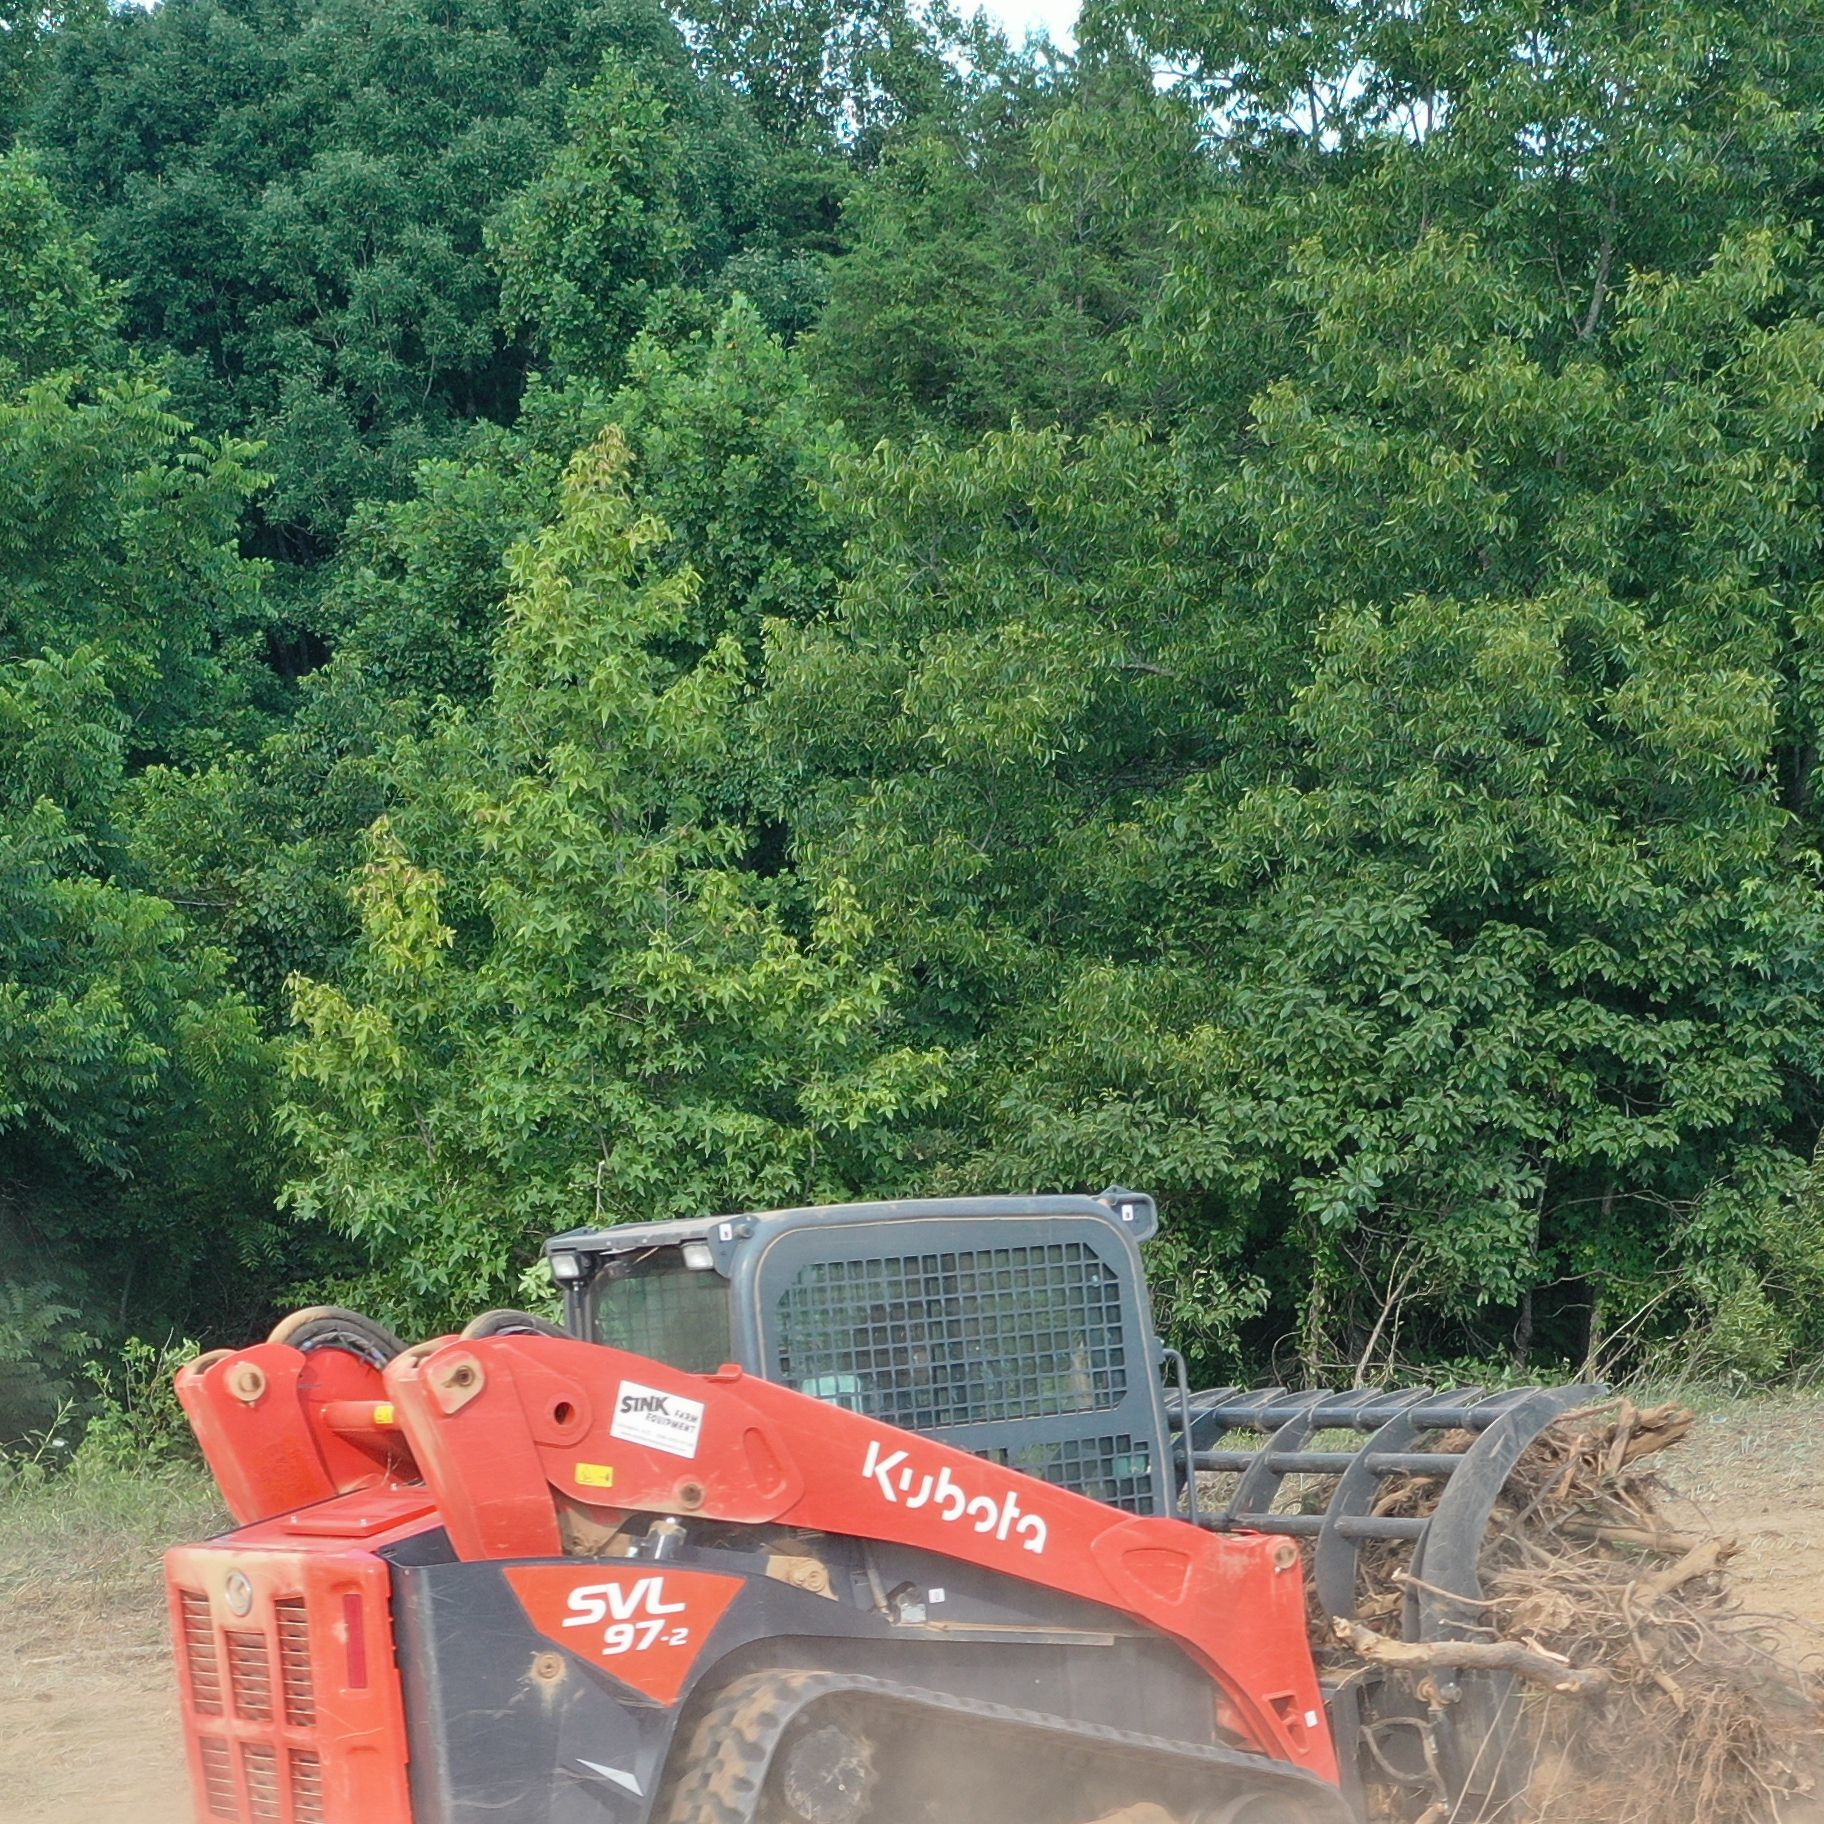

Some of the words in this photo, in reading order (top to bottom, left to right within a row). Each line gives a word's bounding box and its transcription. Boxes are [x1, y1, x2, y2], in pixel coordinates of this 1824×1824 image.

[620, 1395, 670, 1416] SINK
[674, 1409, 698, 1423] FARM
[645, 1412, 697, 1433] EQUIPMENT
[862, 1440, 1047, 1554] Kubota
[561, 1576, 686, 1628] SVL
[601, 1618, 689, 1656] 97-2
